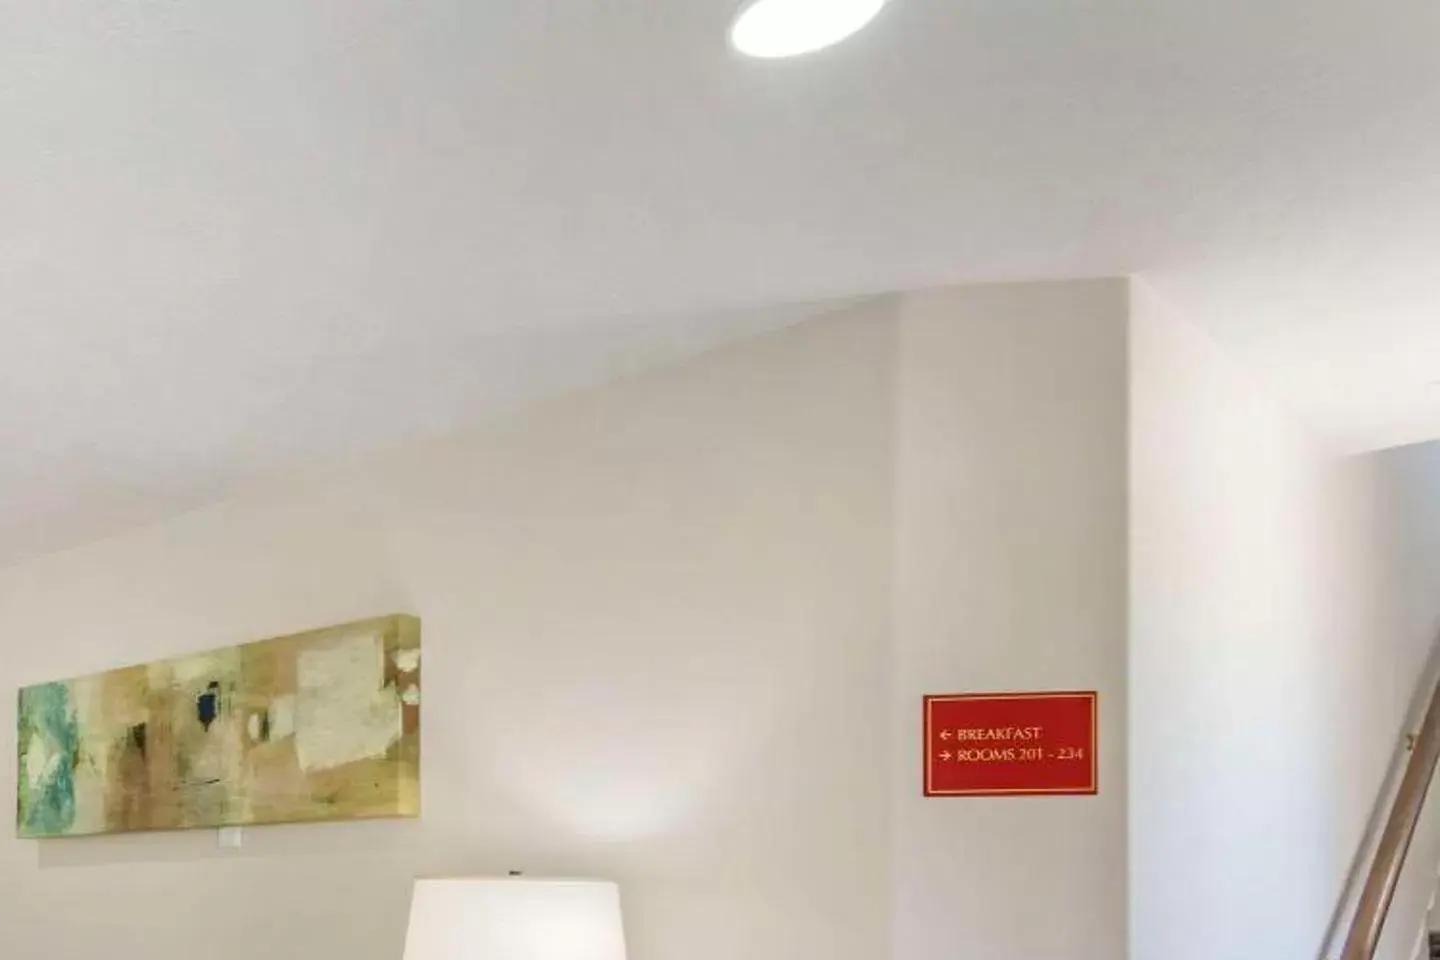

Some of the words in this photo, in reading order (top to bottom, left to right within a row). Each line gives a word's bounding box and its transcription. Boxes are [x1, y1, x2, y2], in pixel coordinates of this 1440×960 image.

[957, 726, 1043, 741] BREAKFAST
[957, 748, 1016, 761] ROOMS
[1019, 747, 1043, 760] 201
[1057, 747, 1084, 760] 234
